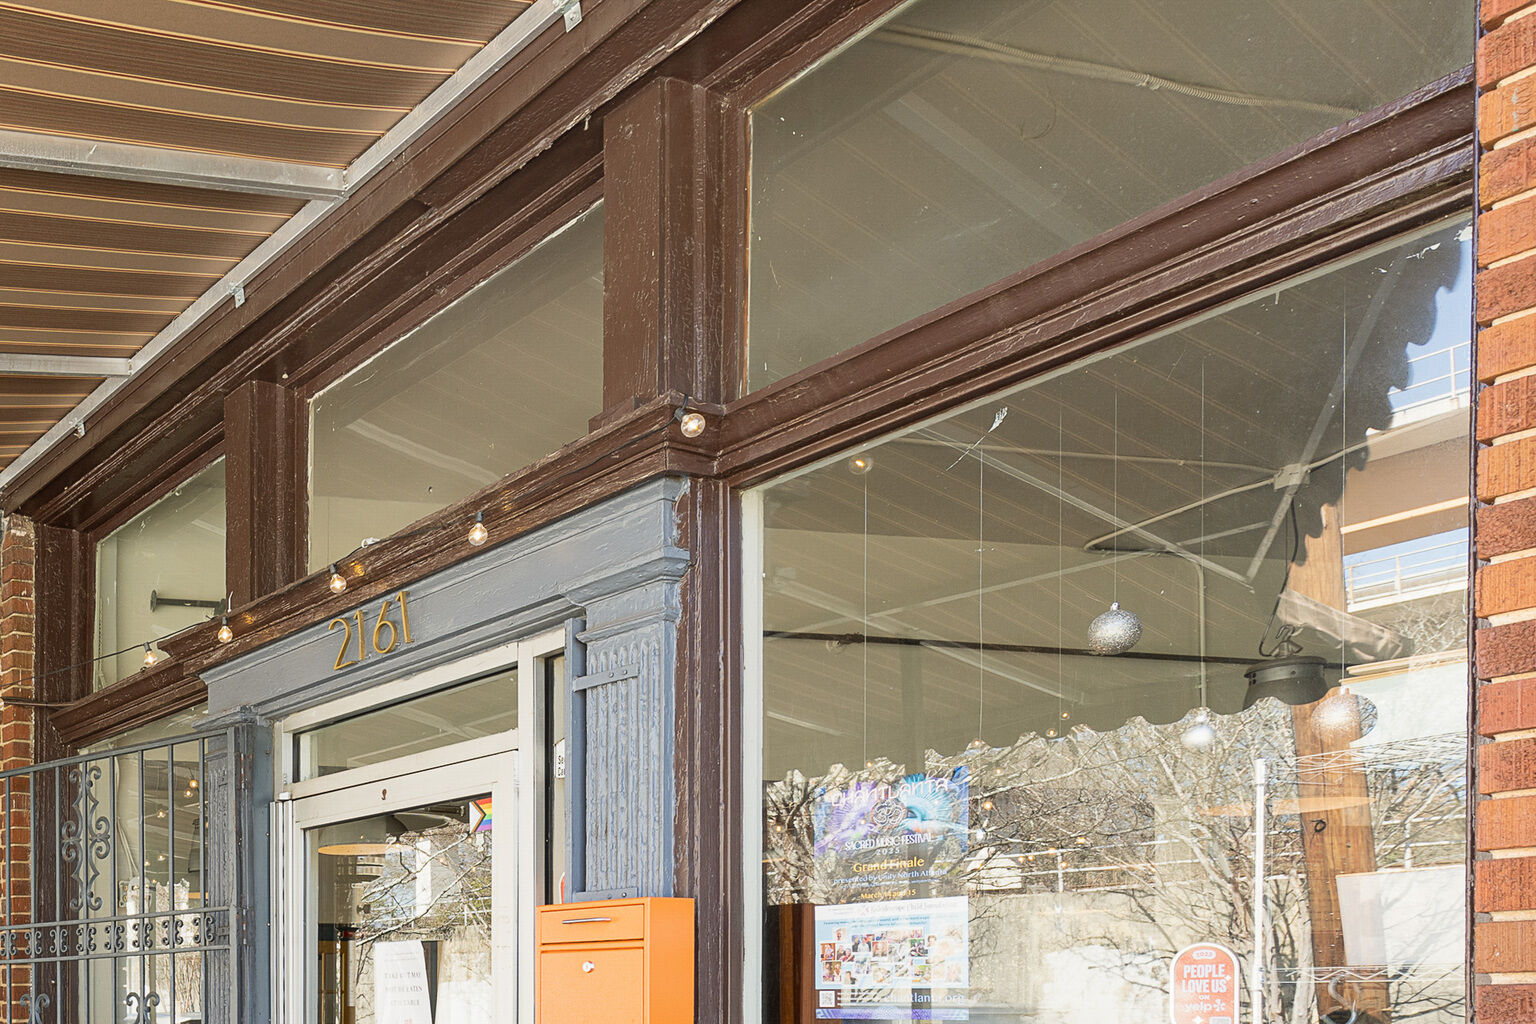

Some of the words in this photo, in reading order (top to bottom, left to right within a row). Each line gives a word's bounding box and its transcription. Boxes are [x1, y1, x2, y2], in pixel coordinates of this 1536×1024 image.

[328, 591, 410, 670] 2161
[845, 840, 874, 851] SACRED
[875, 838, 900, 848] MUSIC
[900, 832, 933, 844] FESTIVAL
[853, 860, 888, 872] Grand
[889, 856, 925, 868] Finale
[898, 869, 920, 878] North
[1184, 964, 1226, 978] PEOPLE
[1182, 979, 1210, 993] LOVE
[1211, 979, 1227, 993] US
[1184, 1001, 1212, 1014] yelp
